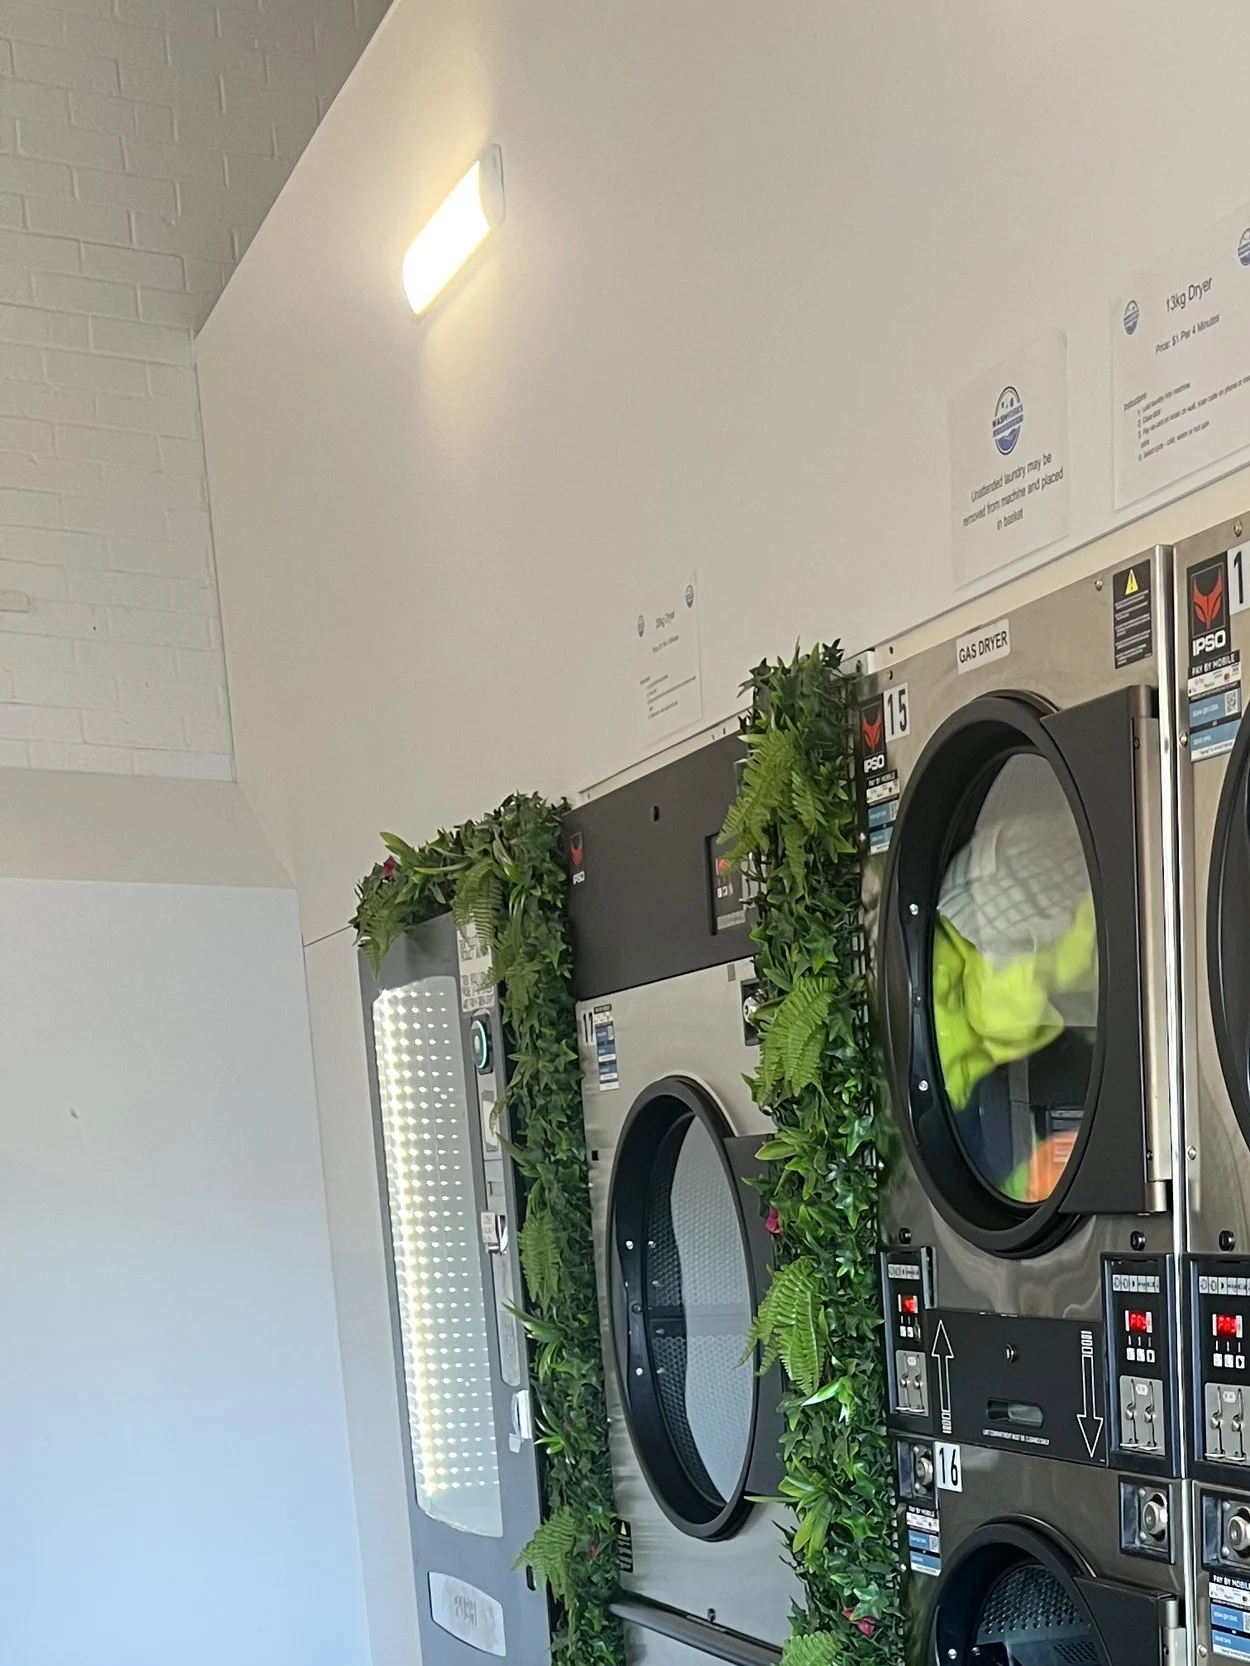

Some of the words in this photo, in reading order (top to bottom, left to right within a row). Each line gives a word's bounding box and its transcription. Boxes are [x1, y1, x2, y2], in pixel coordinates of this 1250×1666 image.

[1166, 293, 1187, 313] 13kg
[1188, 277, 1212, 301] Dryer
[971, 474, 1004, 502] Unattended
[1004, 463, 1026, 485] laundry
[1027, 457, 1042, 474] may
[1043, 453, 1052, 466] be
[987, 498, 1000, 515] from
[1027, 478, 1041, 494] and
[1042, 466, 1064, 490] placed
[959, 644, 977, 664] GAS
[978, 630, 1008, 656] DRYER
[1192, 629, 1226, 657] IPSO
[1191, 664, 1203, 676] PAY
[1204, 661, 1212, 672] BY
[1213, 654, 1235, 669] MOBILE
[888, 689, 907, 735] 15
[864, 754, 885, 774] IPSO
[938, 1447, 959, 1487] 16
[1213, 1575, 1223, 1584] PAY
[1224, 1577, 1231, 1586] BY
